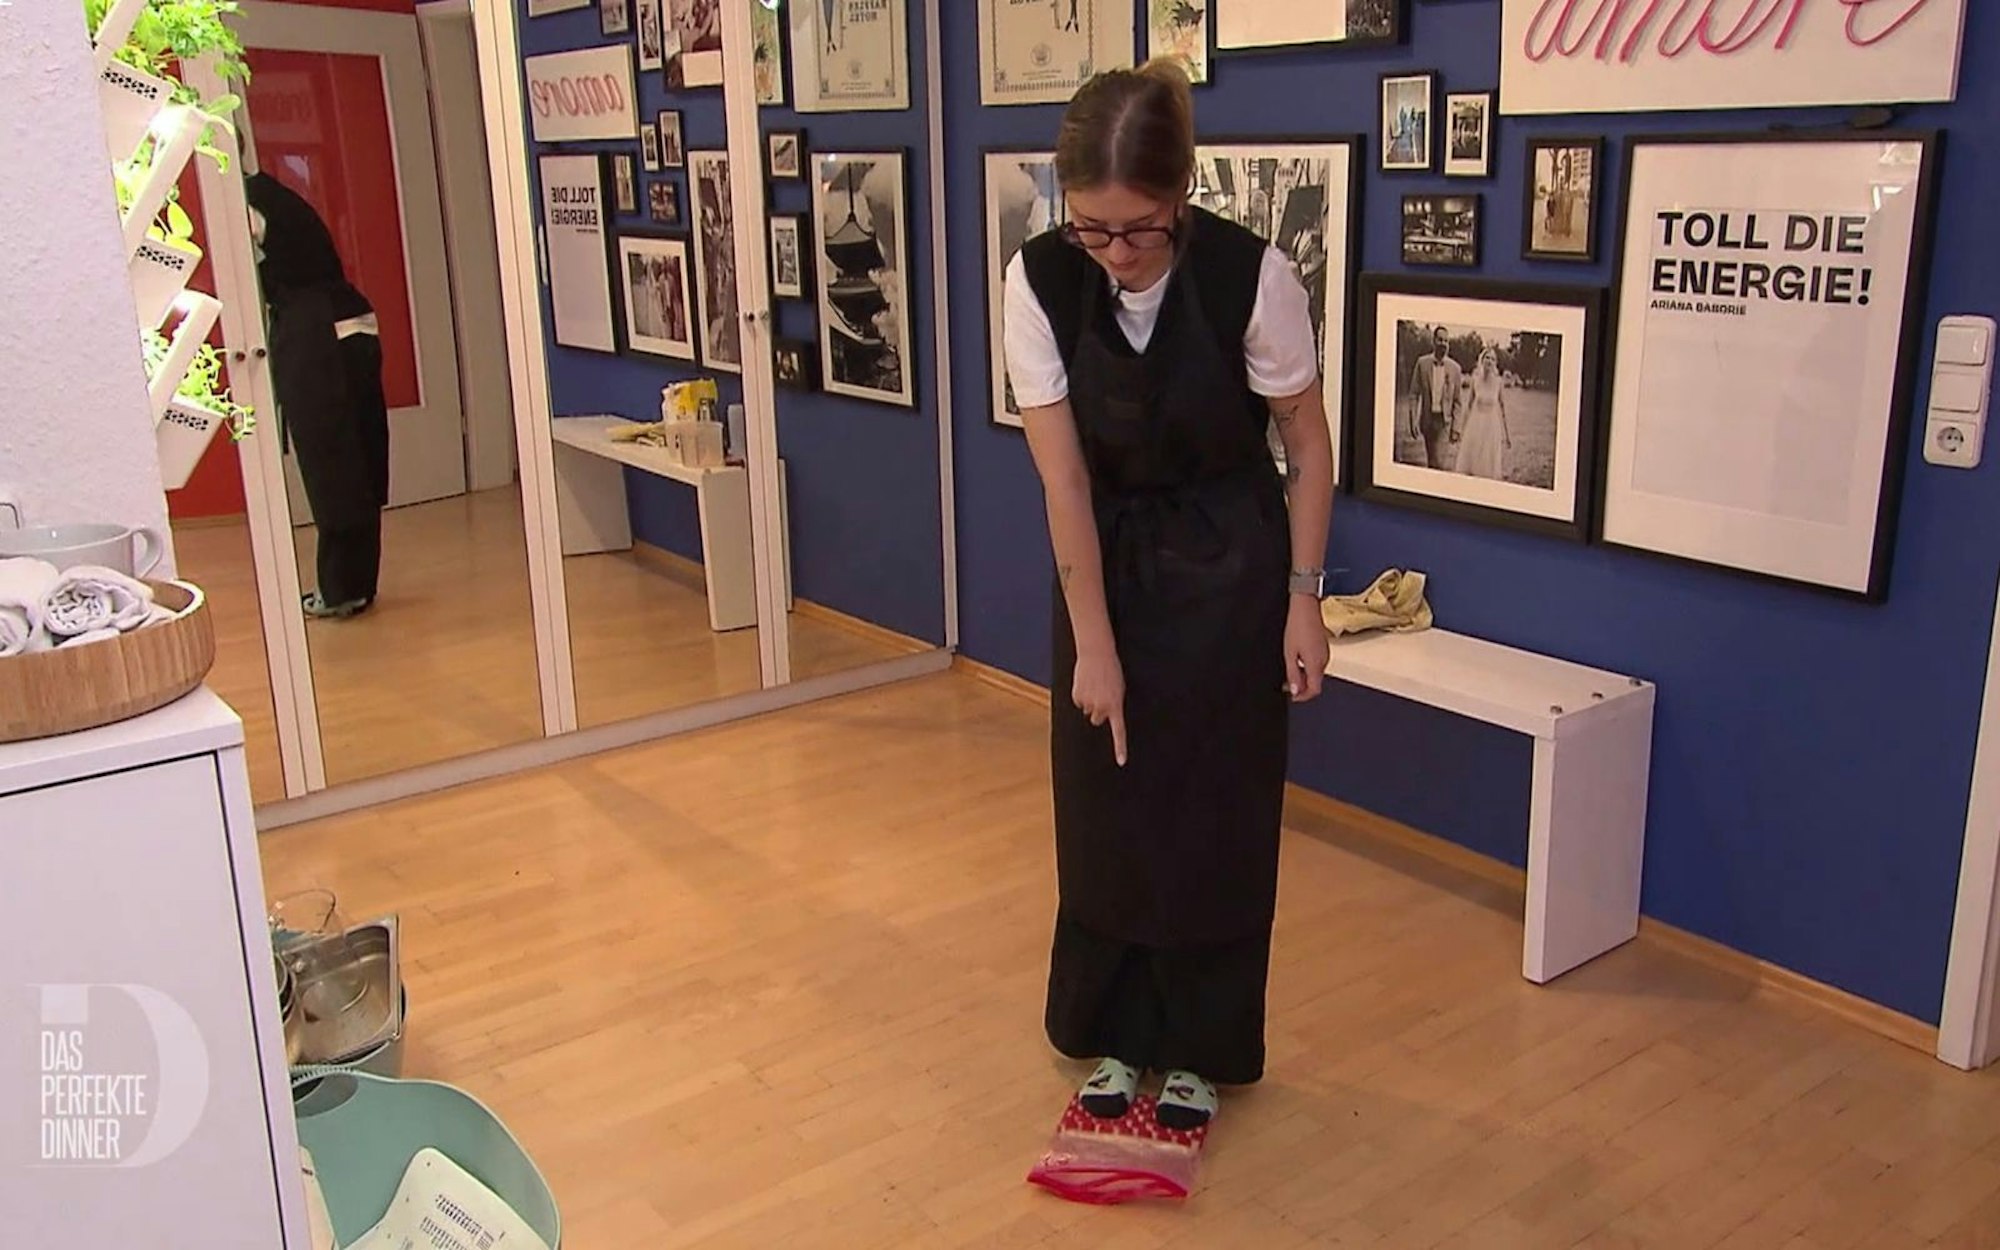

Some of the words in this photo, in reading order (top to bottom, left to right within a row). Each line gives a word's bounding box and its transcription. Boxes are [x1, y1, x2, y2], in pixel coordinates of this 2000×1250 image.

[1657, 212, 1768, 249] TOLL
[1784, 215, 1867, 254] DIE
[1652, 258, 1872, 306] ENERGIE!
[1650, 299, 1693, 312] ARIANA
